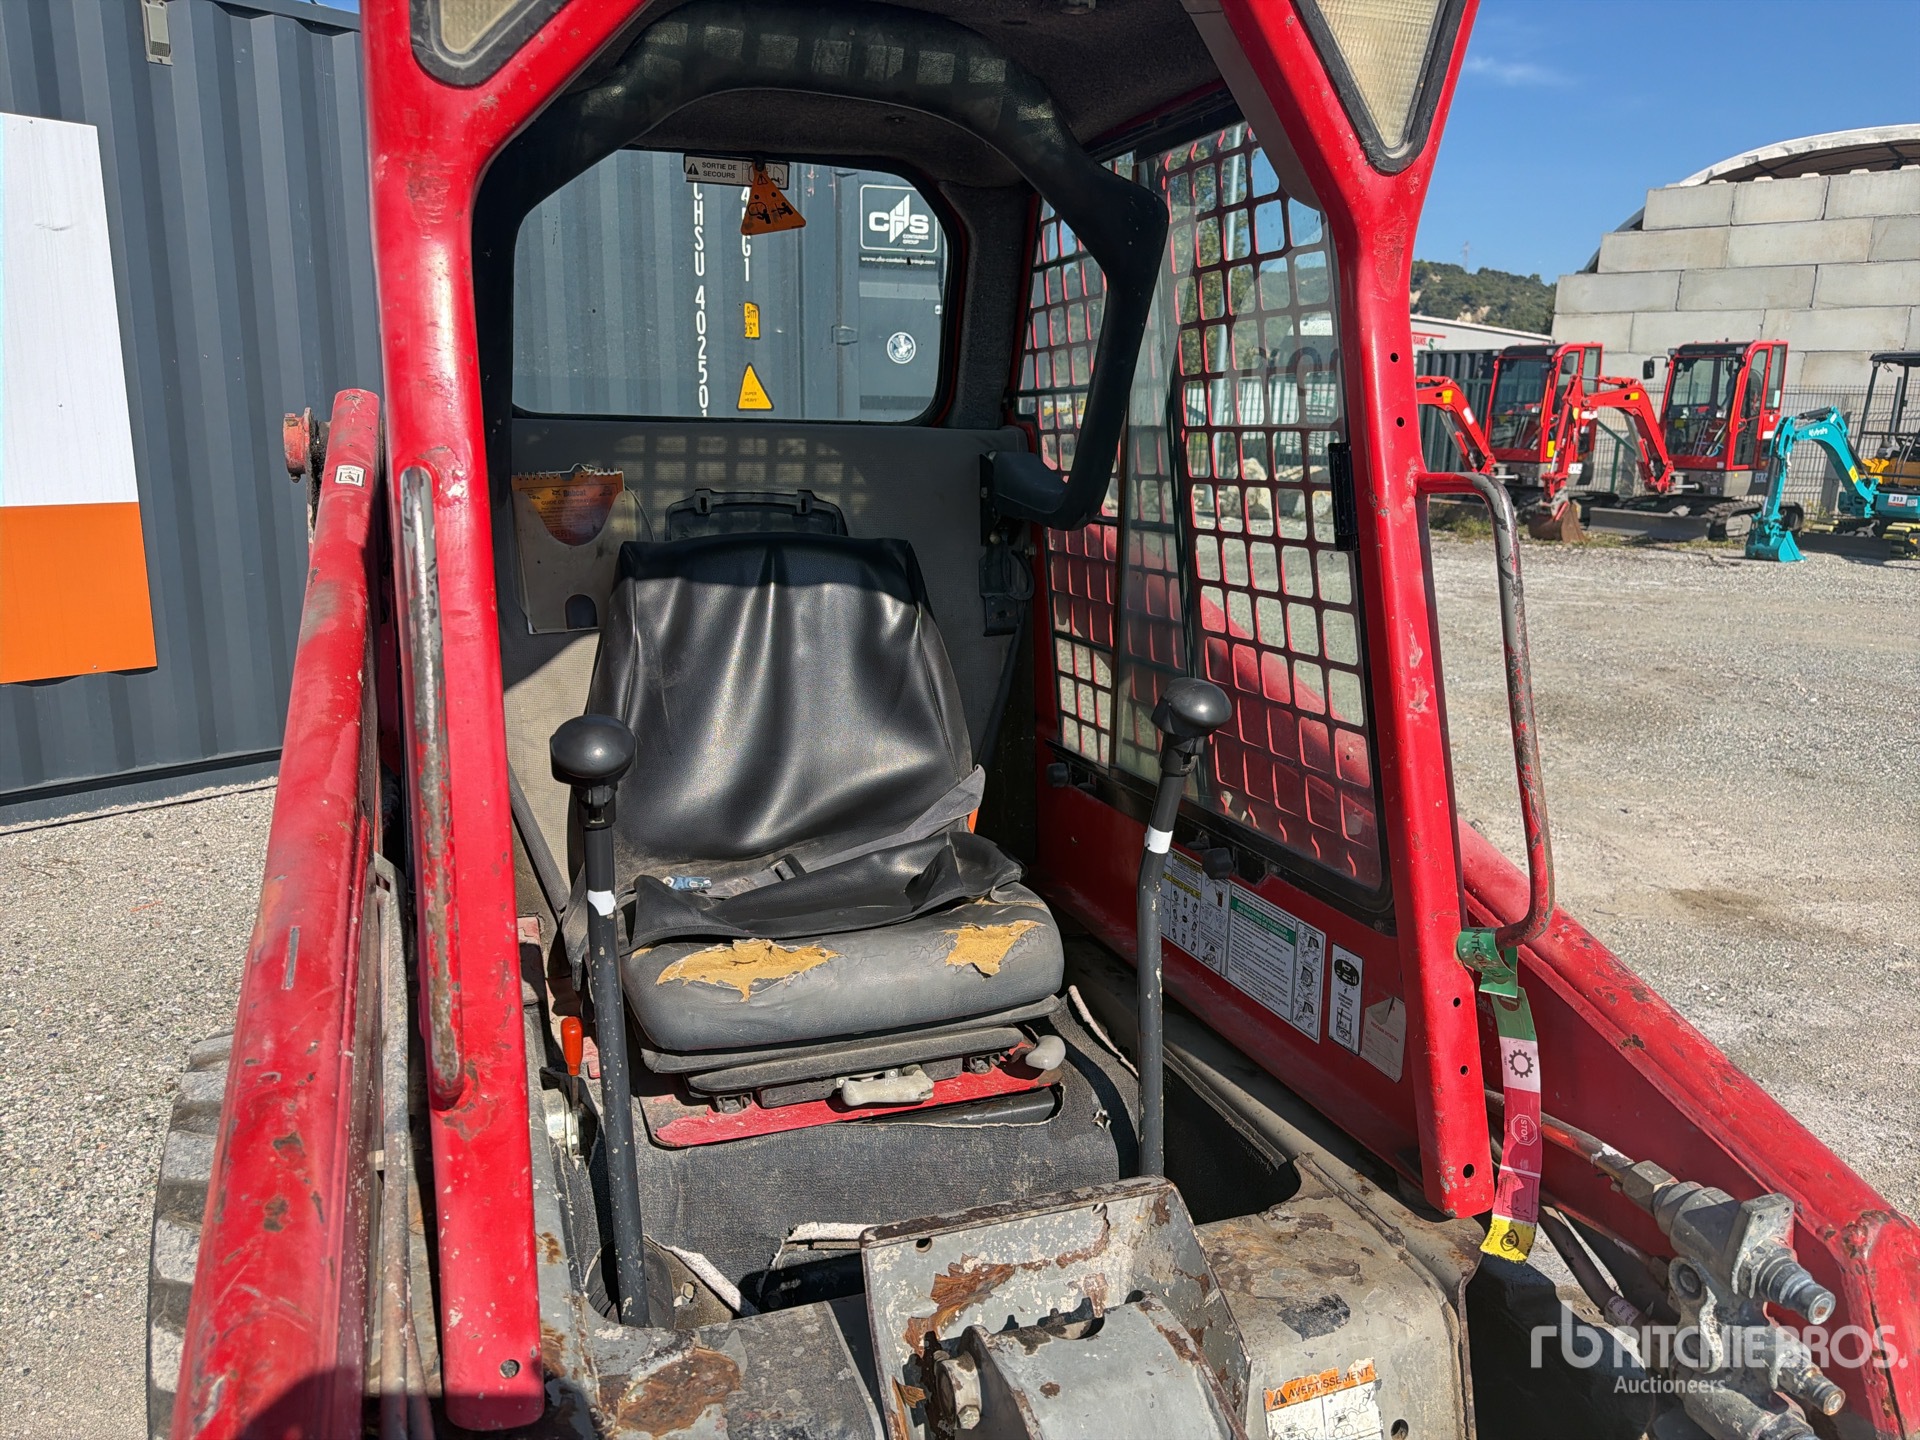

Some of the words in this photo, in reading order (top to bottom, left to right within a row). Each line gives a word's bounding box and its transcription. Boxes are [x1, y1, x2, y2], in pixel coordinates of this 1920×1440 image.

[702, 161, 727, 170] SORTIE
[703, 170, 736, 179] SECOURS
[868, 193, 930, 244] CHS
[741, 187, 751, 282] 4G1
[1808, 426, 1828, 437] Kubota
[563, 489, 586, 498] Bobcat
[1520, 1119, 1528, 1142] STOP
